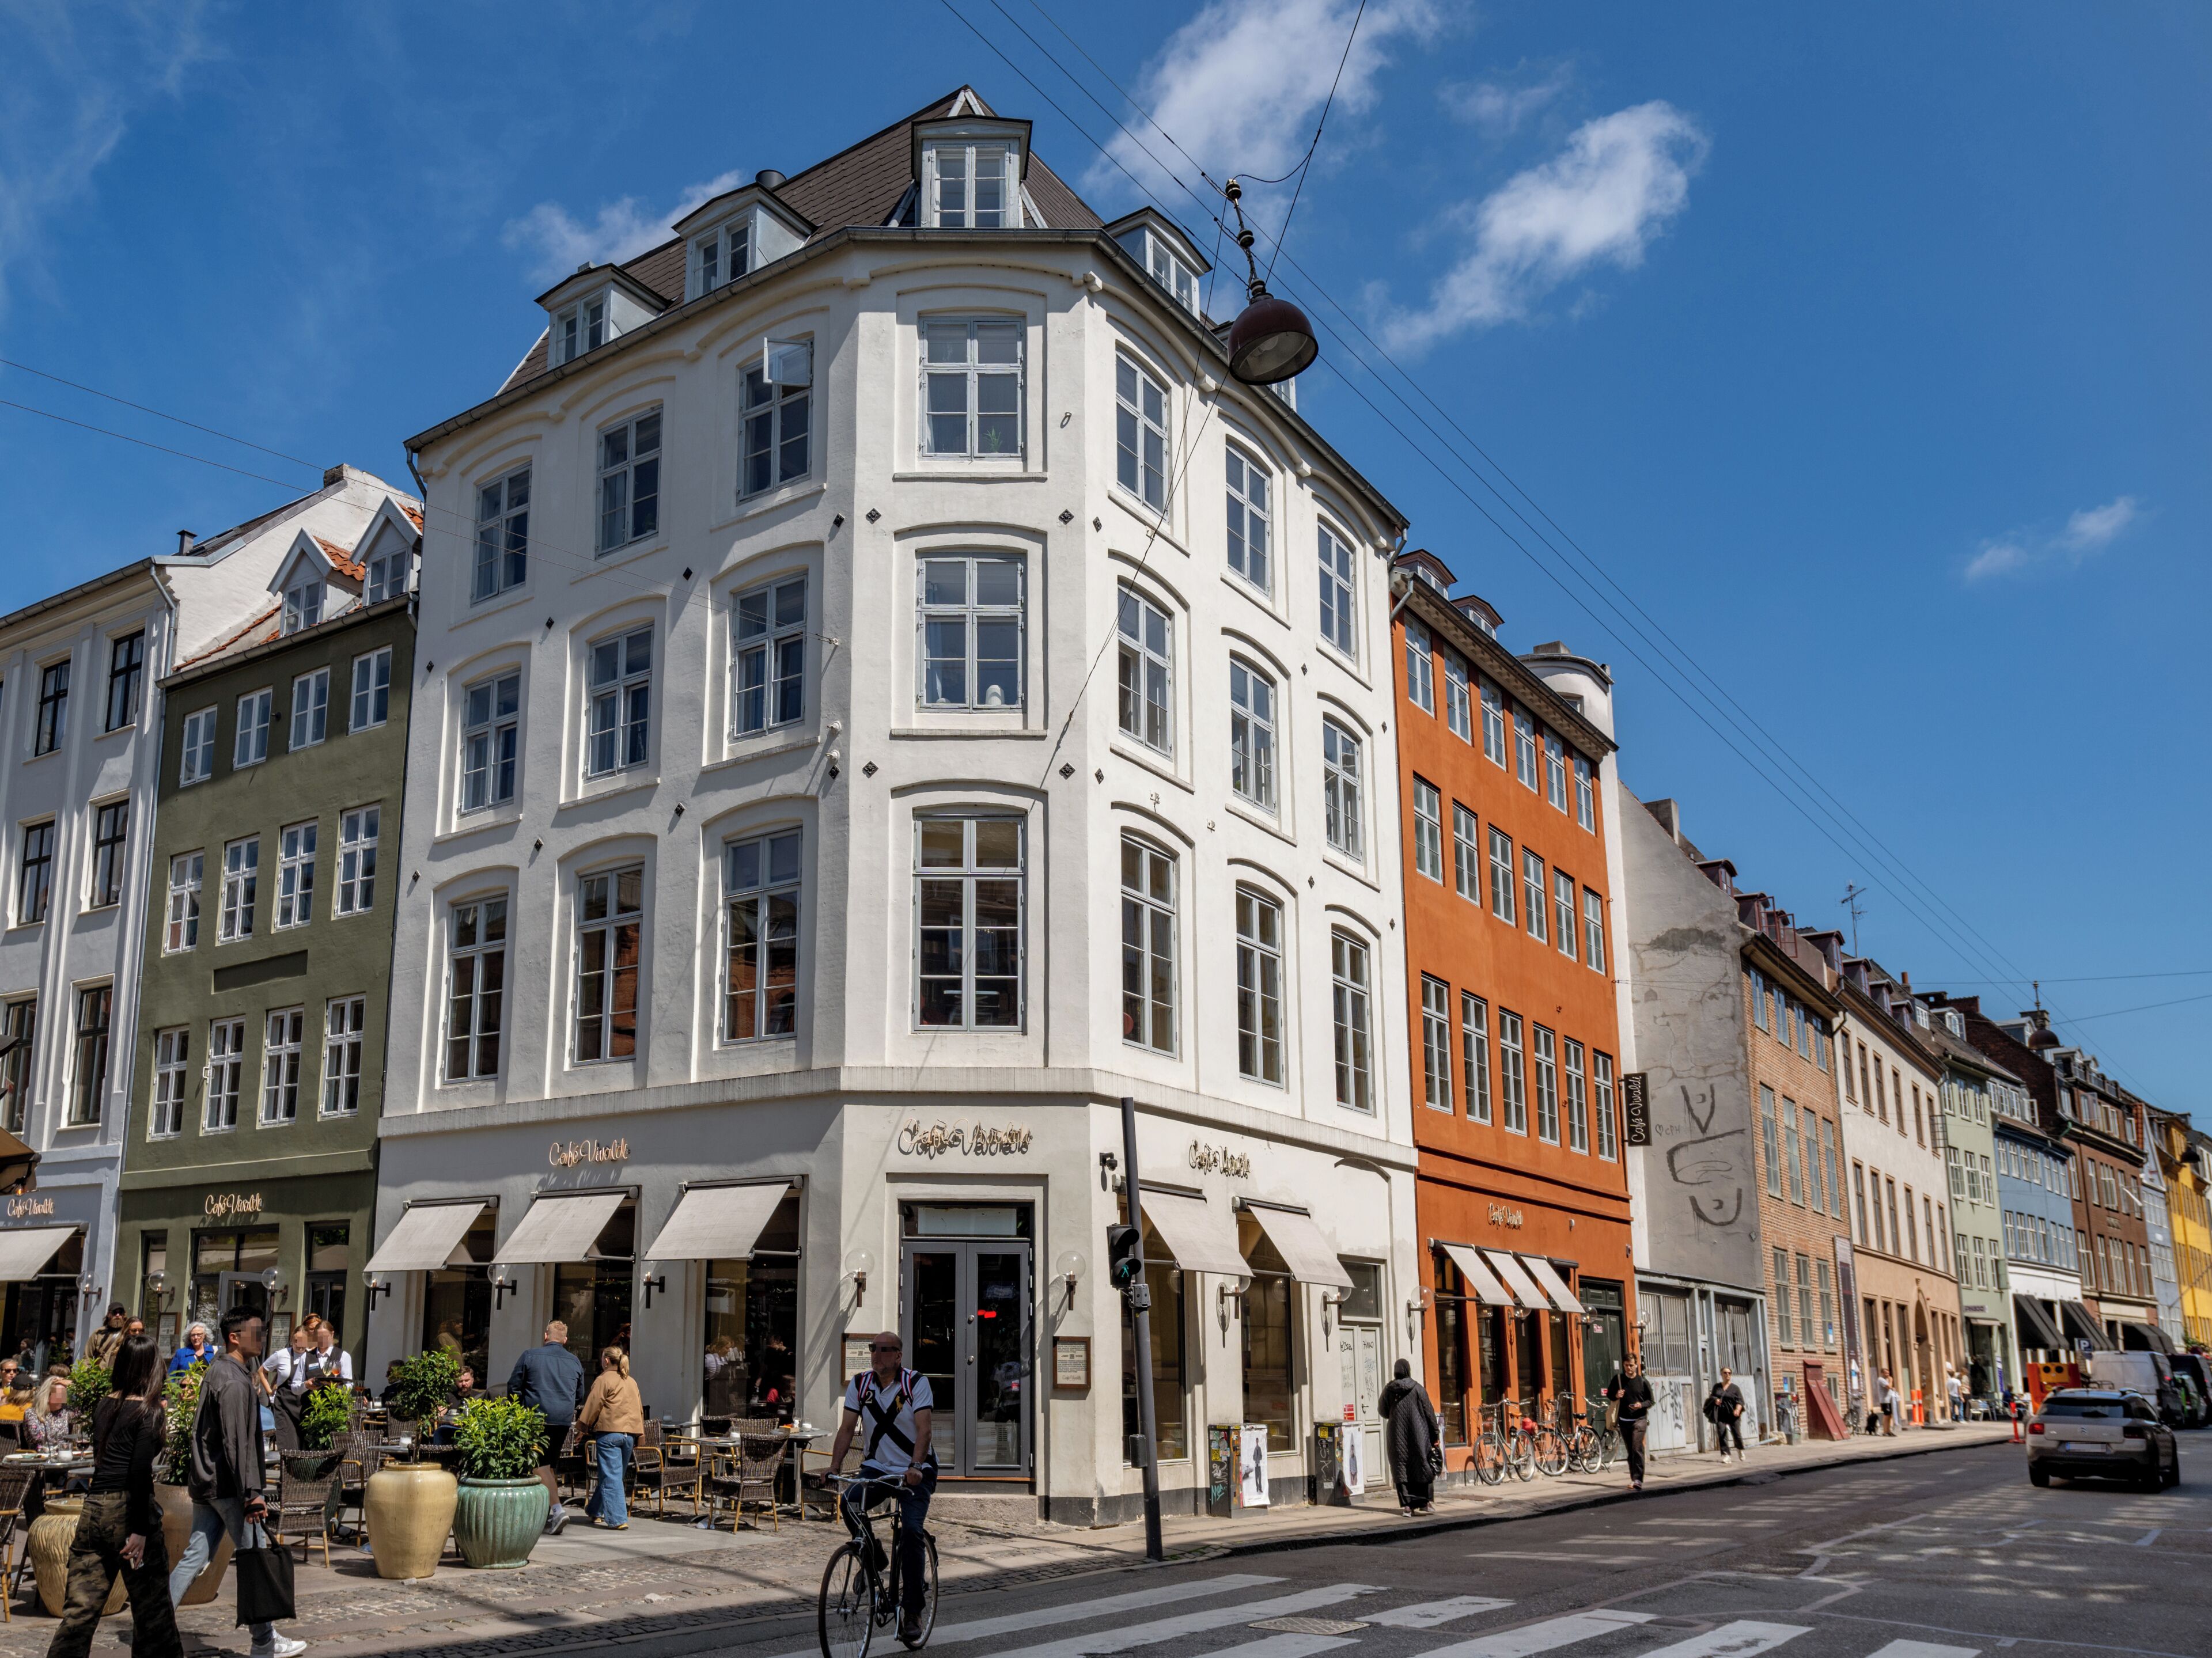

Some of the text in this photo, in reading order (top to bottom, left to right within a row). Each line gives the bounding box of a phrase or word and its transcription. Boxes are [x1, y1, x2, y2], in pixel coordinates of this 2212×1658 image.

[1628, 1076, 1646, 1142] Café Vivaldi
[549, 1138, 628, 1167] Café Vivaldi
[7, 1198, 25, 1218] Café
[205, 1193, 262, 1217] Café Vivaldi
[2080, 1340, 2089, 1350] P
[865, 1391, 873, 1403] 2
